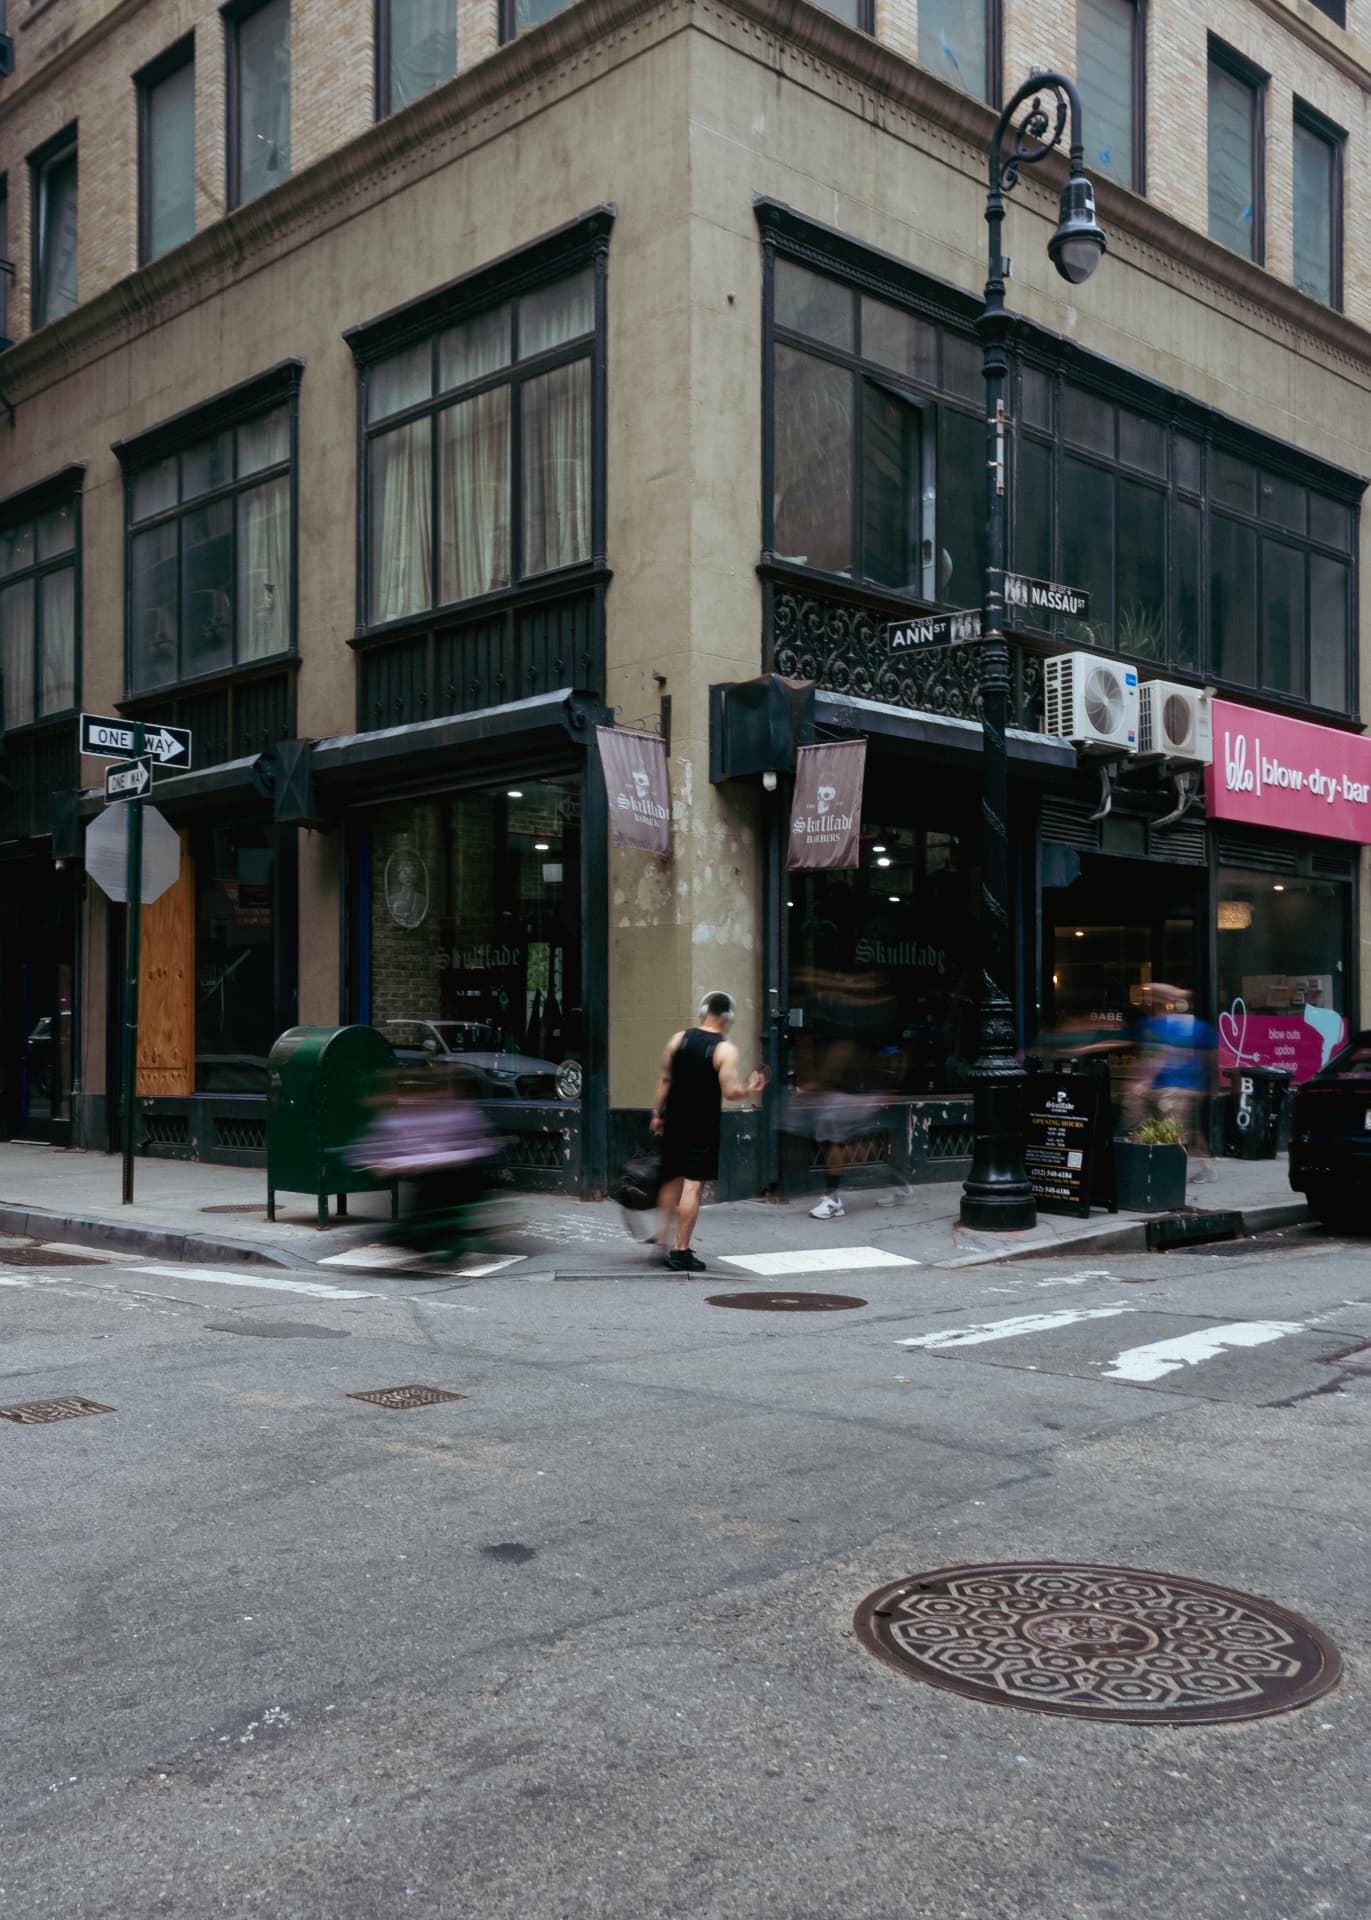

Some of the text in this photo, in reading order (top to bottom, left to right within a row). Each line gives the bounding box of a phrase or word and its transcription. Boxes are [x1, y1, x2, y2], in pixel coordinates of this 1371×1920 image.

[1032, 586, 1078, 614] NASSAU
[1078, 599, 1085, 609] ST
[892, 627, 934, 647] ANN
[934, 622, 947, 633] ST
[98, 729, 129, 747] ONE
[144, 737, 174, 753] WAY
[1225, 731, 1254, 792] blo
[111, 774, 125, 791] ONE
[1090, 1012, 1124, 1021] BABE
[1237, 1077, 1254, 1128] BLO
[1031, 1184, 1044, 1193] 212)
